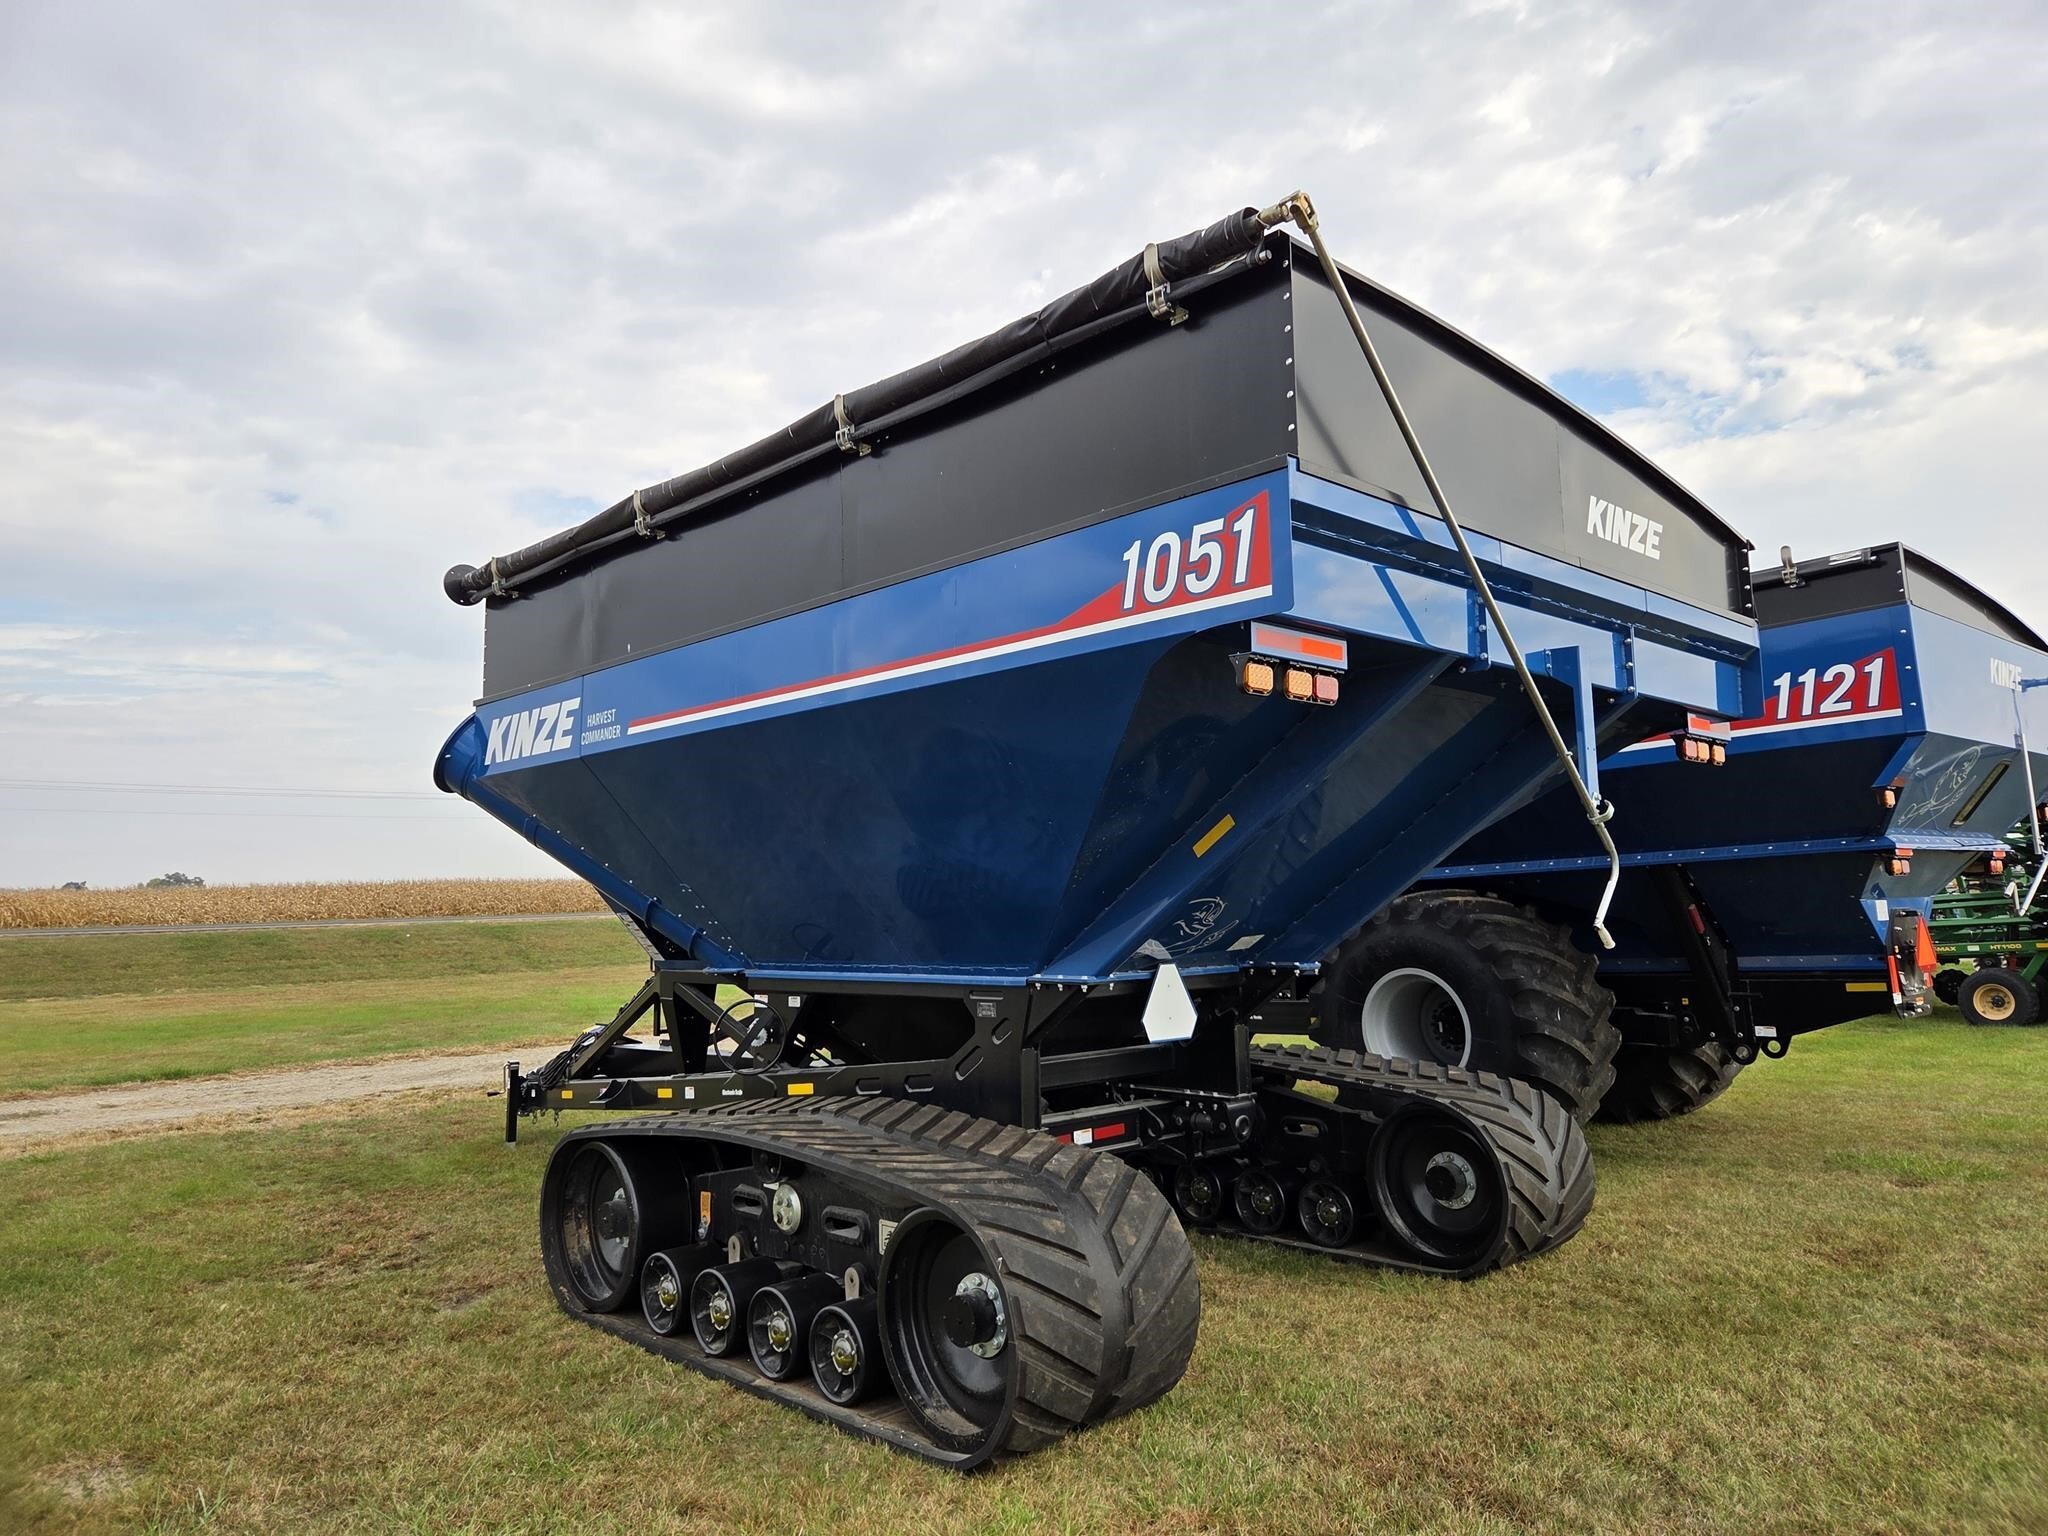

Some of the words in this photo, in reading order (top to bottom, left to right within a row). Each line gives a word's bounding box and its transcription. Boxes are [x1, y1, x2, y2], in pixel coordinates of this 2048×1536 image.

[1122, 508, 1255, 610] 1051
[1587, 495, 1663, 561] KINZE
[1773, 657, 1884, 720] 1121
[1990, 657, 2022, 692] KINZE
[484, 697, 581, 766] KINZE
[581, 725, 621, 746] COMMANDER
[587, 709, 616, 728] HARVEST
